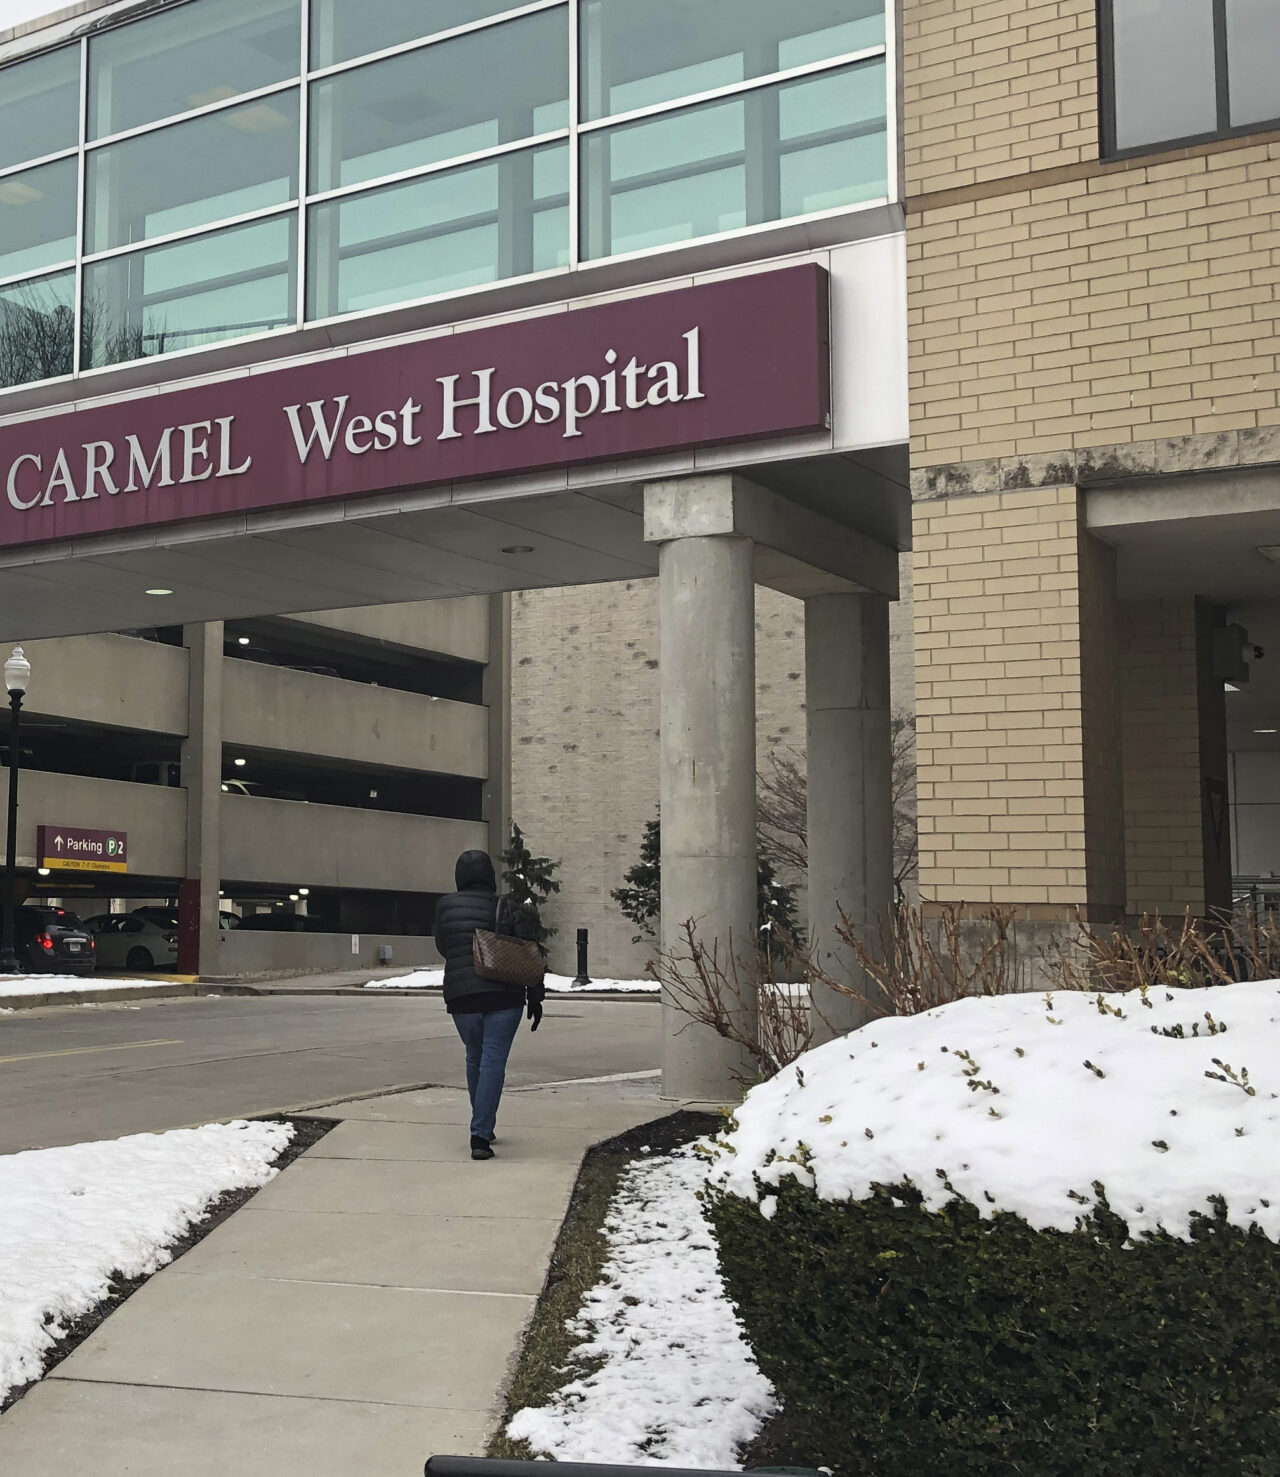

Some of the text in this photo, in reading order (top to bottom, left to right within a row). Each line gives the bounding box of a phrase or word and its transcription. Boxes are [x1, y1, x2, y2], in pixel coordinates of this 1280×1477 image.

[6, 416, 251, 511] CARMEL
[283, 393, 421, 462] West
[435, 327, 704, 441] Hospital
[67, 838, 124, 854] Parking P 2
